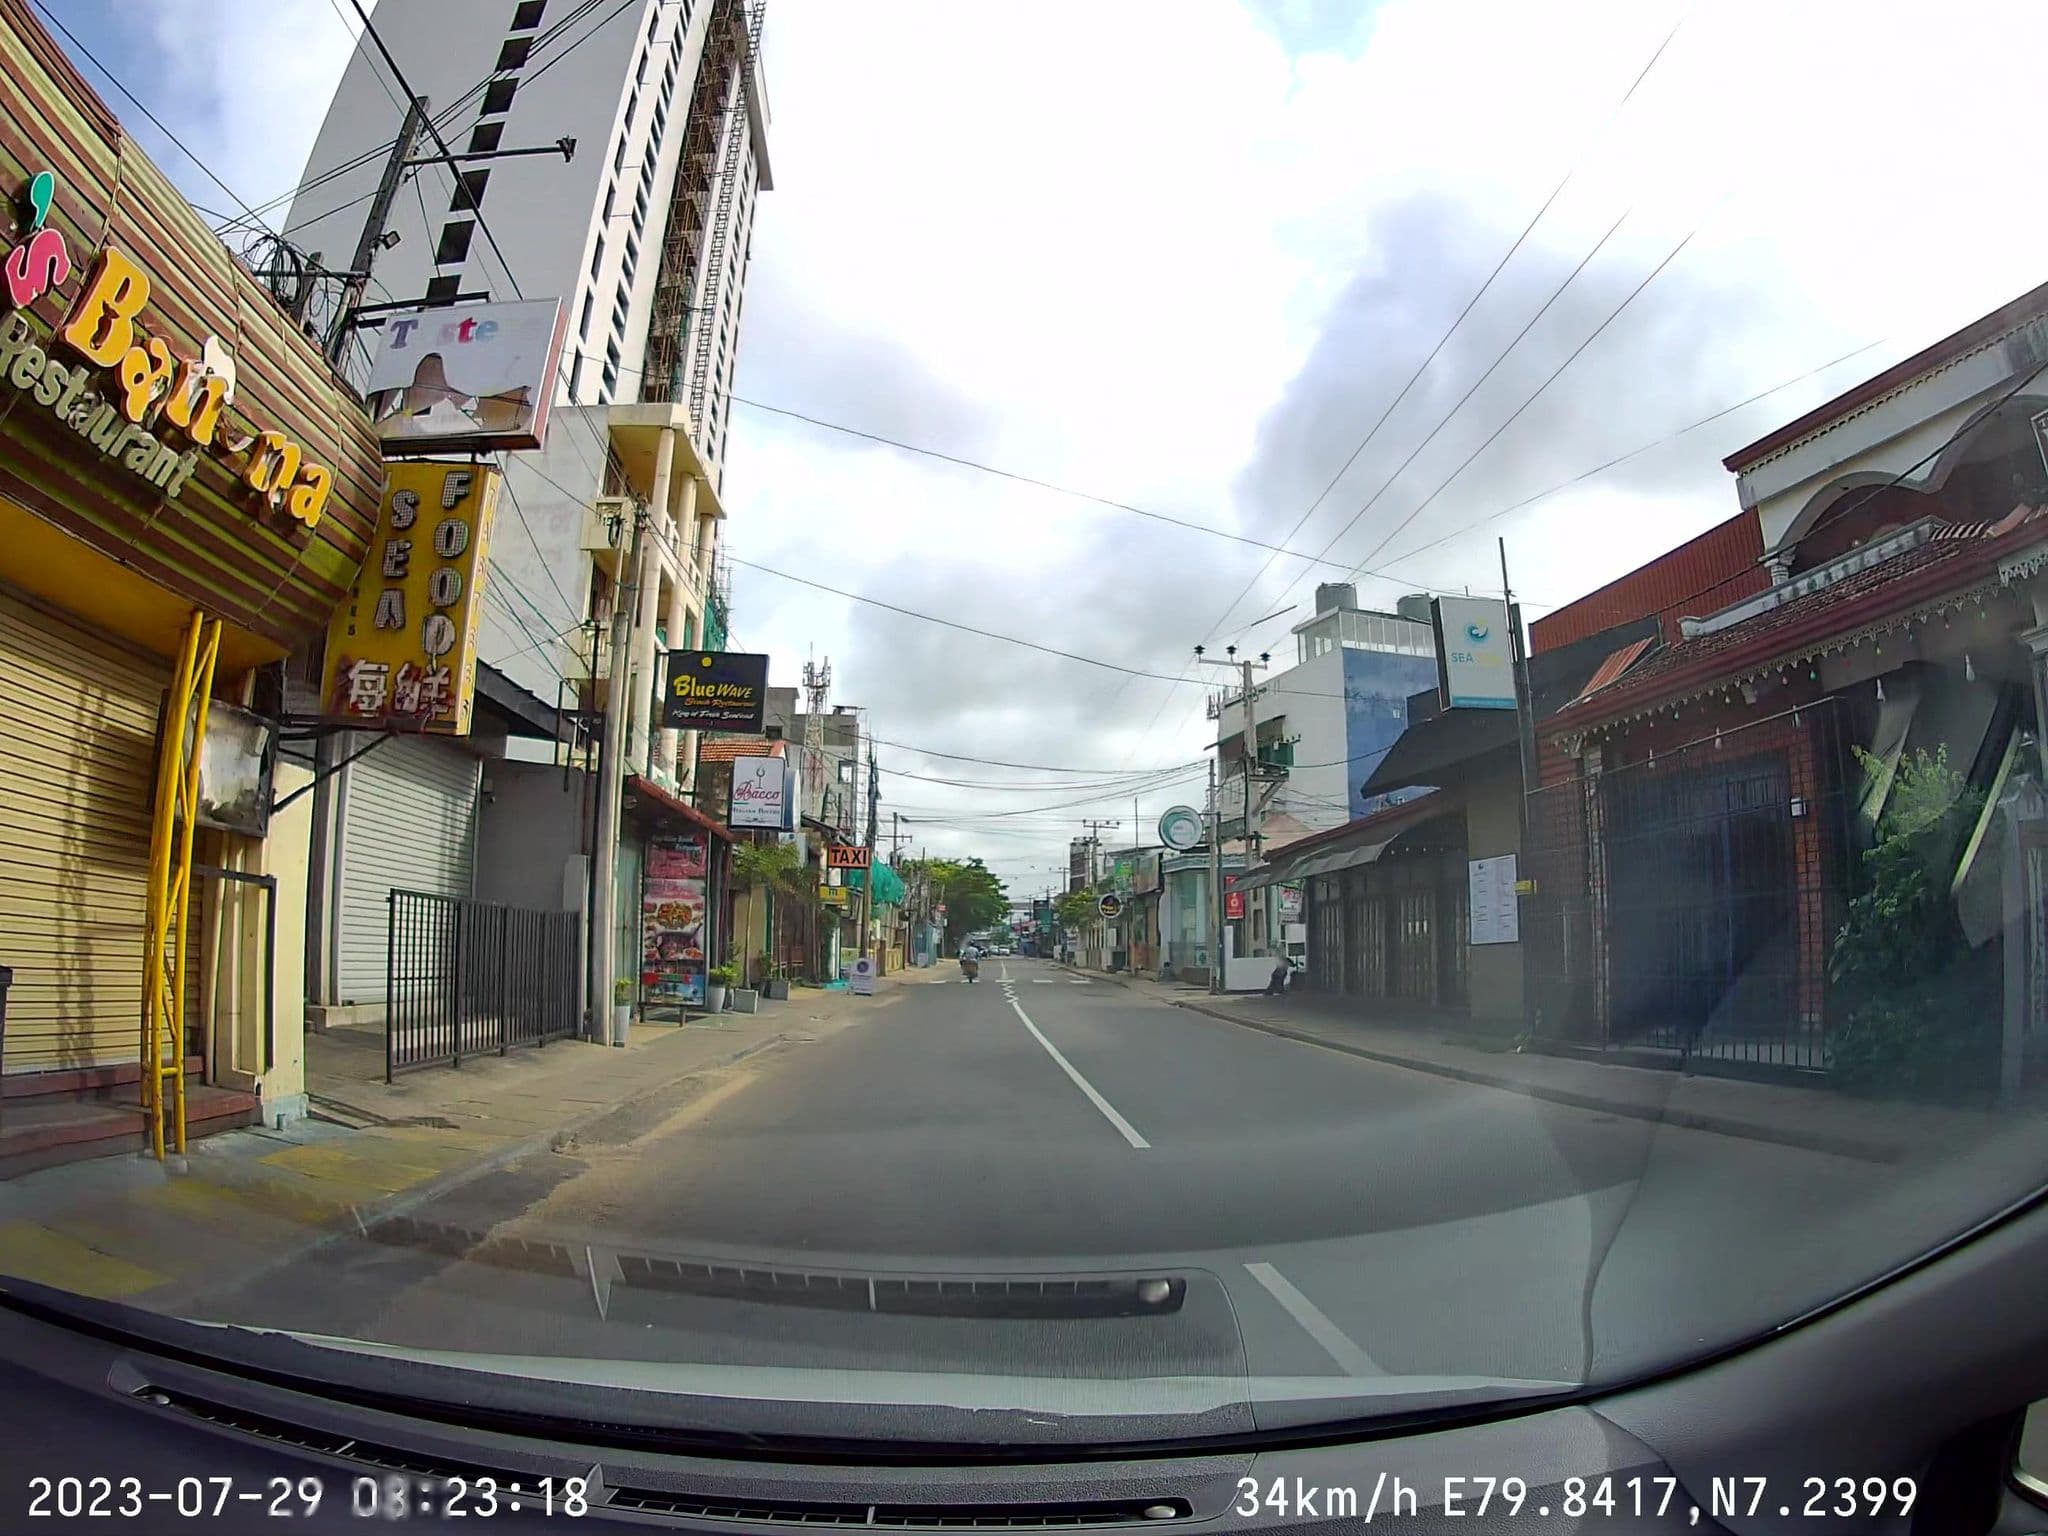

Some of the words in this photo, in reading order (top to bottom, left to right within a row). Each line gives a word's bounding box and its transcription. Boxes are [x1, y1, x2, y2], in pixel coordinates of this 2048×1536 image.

[0, 311, 199, 499] Restaurant
[374, 488, 420, 630] SEA
[421, 471, 473, 656] FOOD
[1451, 652, 1473, 663] SEA
[673, 674, 716, 698] Blue
[716, 683, 753, 699] WAVE
[733, 779, 781, 801] Bacco
[832, 849, 867, 865] TAXI
